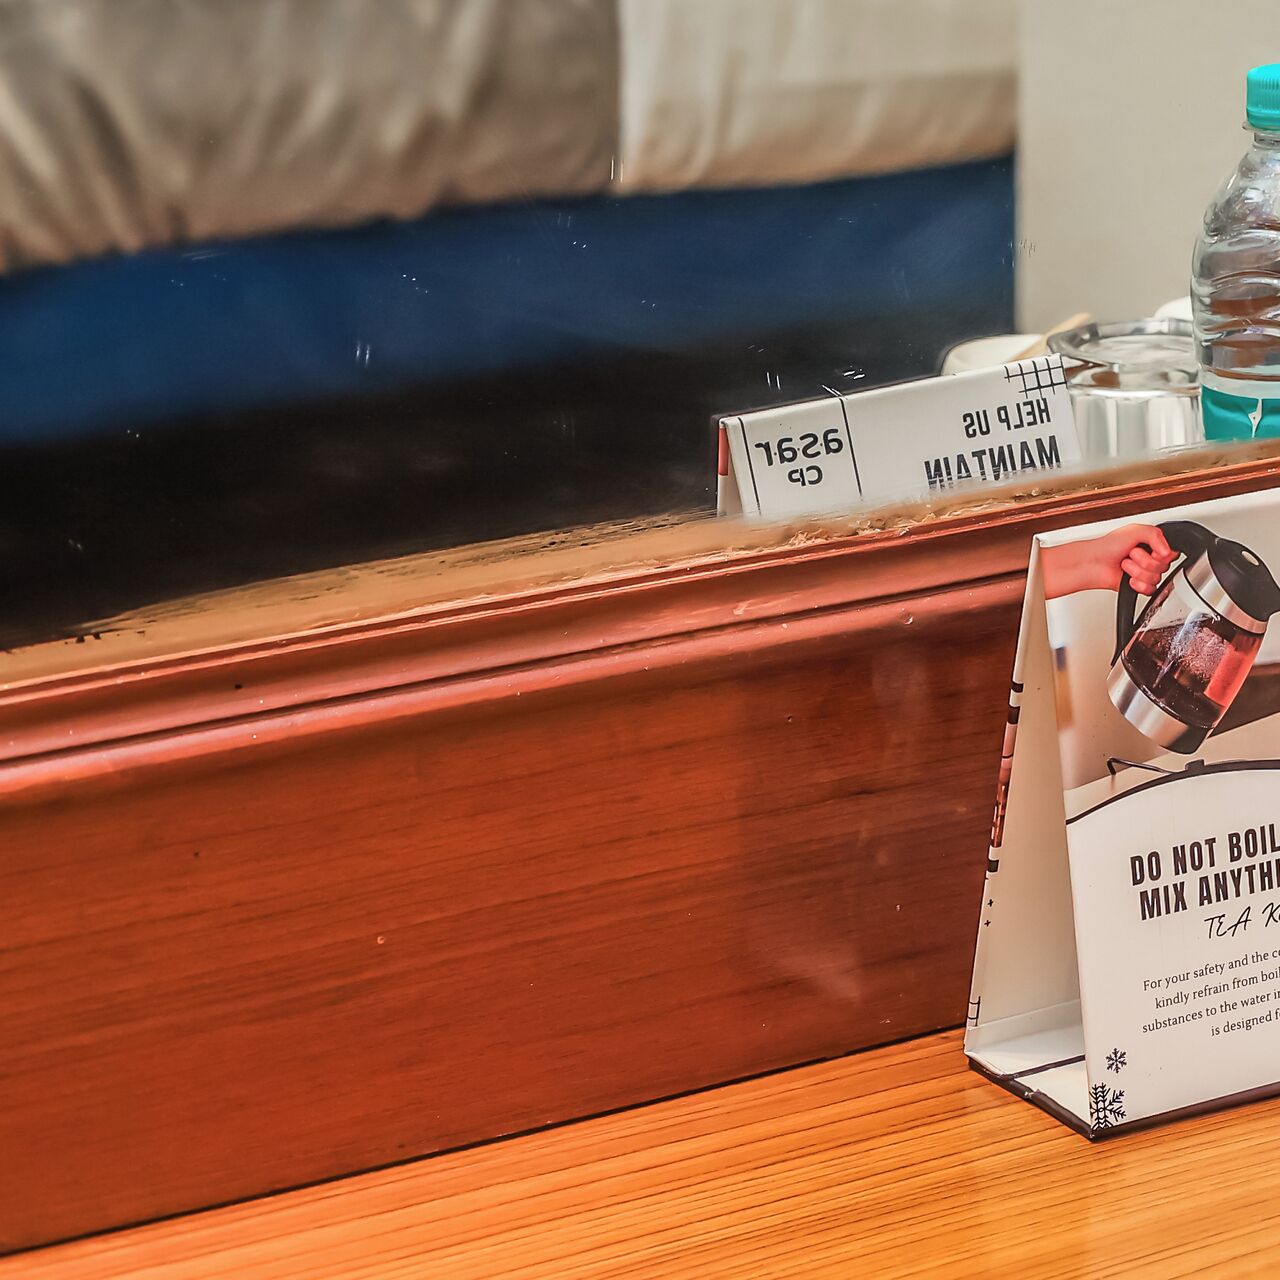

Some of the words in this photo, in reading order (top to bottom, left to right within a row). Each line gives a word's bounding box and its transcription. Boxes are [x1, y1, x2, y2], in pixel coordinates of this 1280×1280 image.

[1130, 850, 1162, 886] DO
[1172, 838, 1216, 875] NOT
[1140, 881, 1188, 920] MIX
[1204, 906, 1252, 939] TEA
[1143, 979, 1162, 991] For
[1165, 972, 1190, 989] your
[1193, 963, 1225, 978] safety
[1228, 954, 1248, 970] and
[1252, 952, 1269, 964] the
[1155, 992, 1190, 1009] kindly
[1192, 982, 1230, 1000] refrain
[1232, 975, 1258, 990] from
[1142, 1010, 1203, 1033] substances
[1206, 1006, 1217, 1017] to
[1220, 1000, 1238, 1014] the
[1240, 992, 1272, 1008] water
[1210, 1026, 1220, 1036] is
[1222, 1010, 1272, 1033] designed
